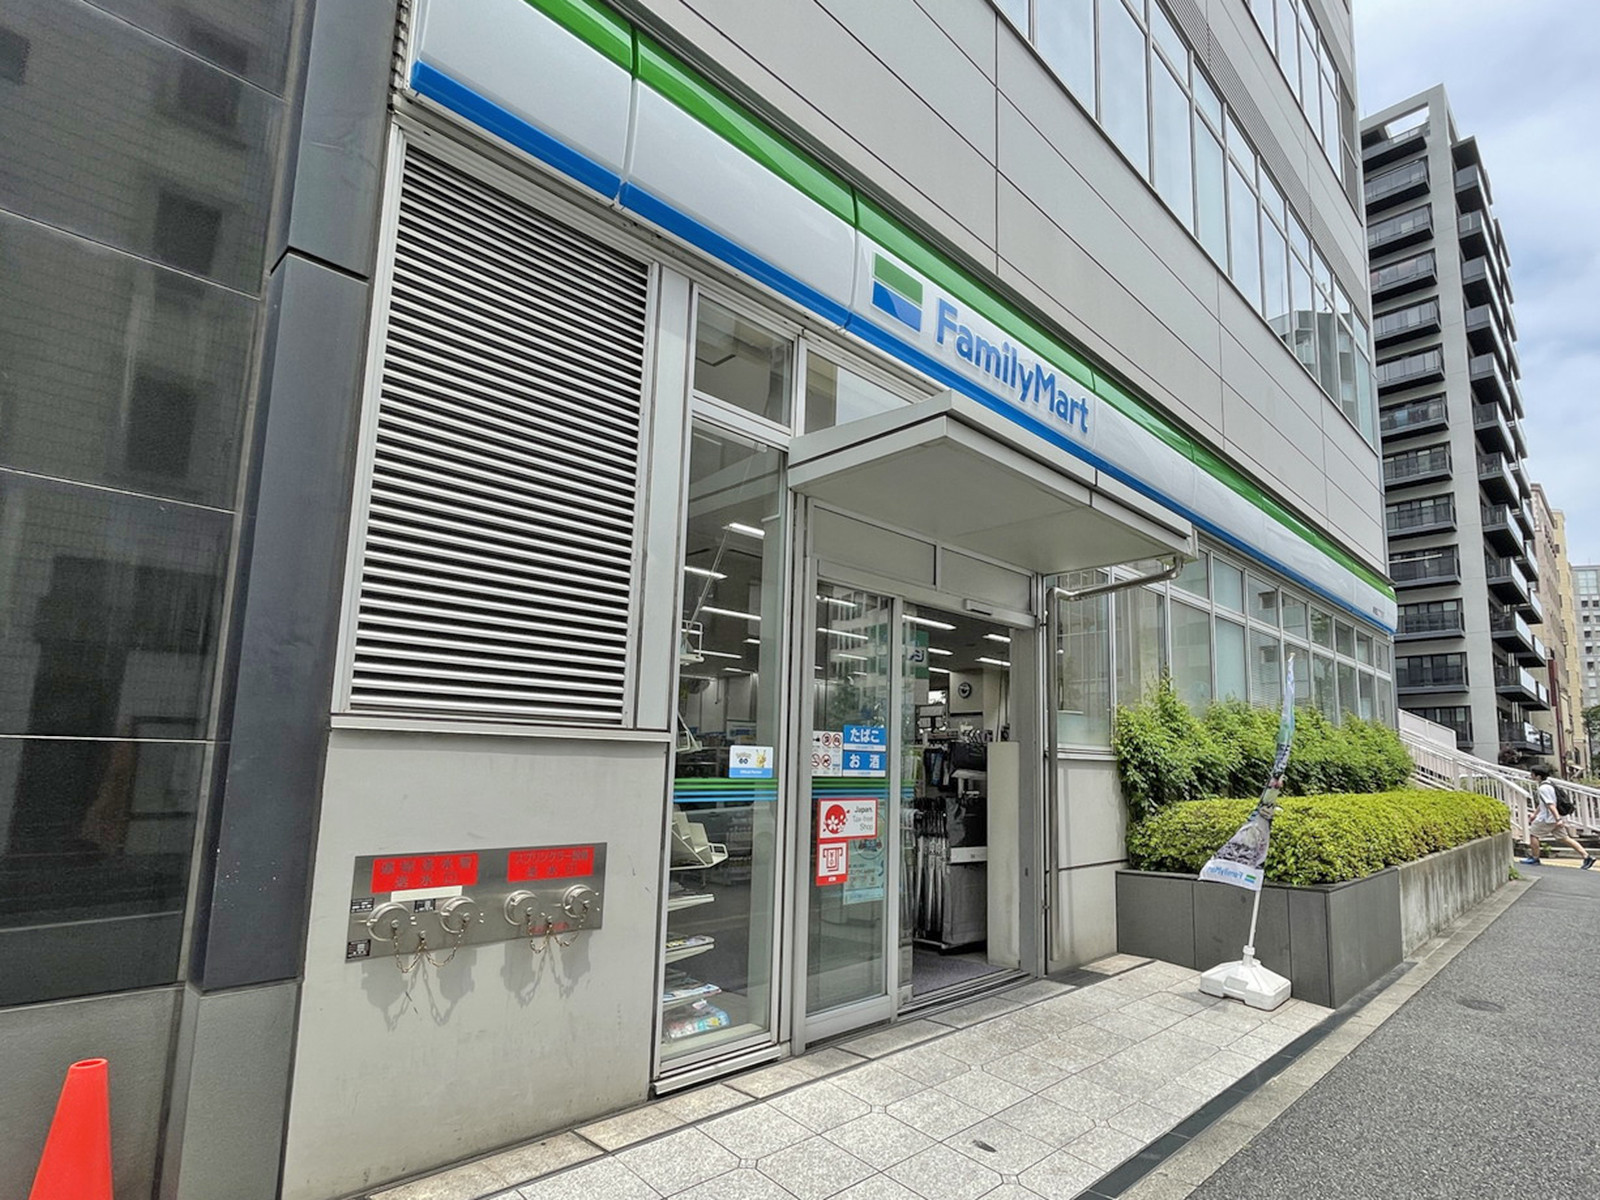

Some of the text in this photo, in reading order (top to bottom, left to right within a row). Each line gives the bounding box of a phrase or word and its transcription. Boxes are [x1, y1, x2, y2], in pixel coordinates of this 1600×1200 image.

[935, 297, 1089, 433] FamilyMart
[849, 727, 880, 744] たばこ
[849, 753, 880, 769] お酒
